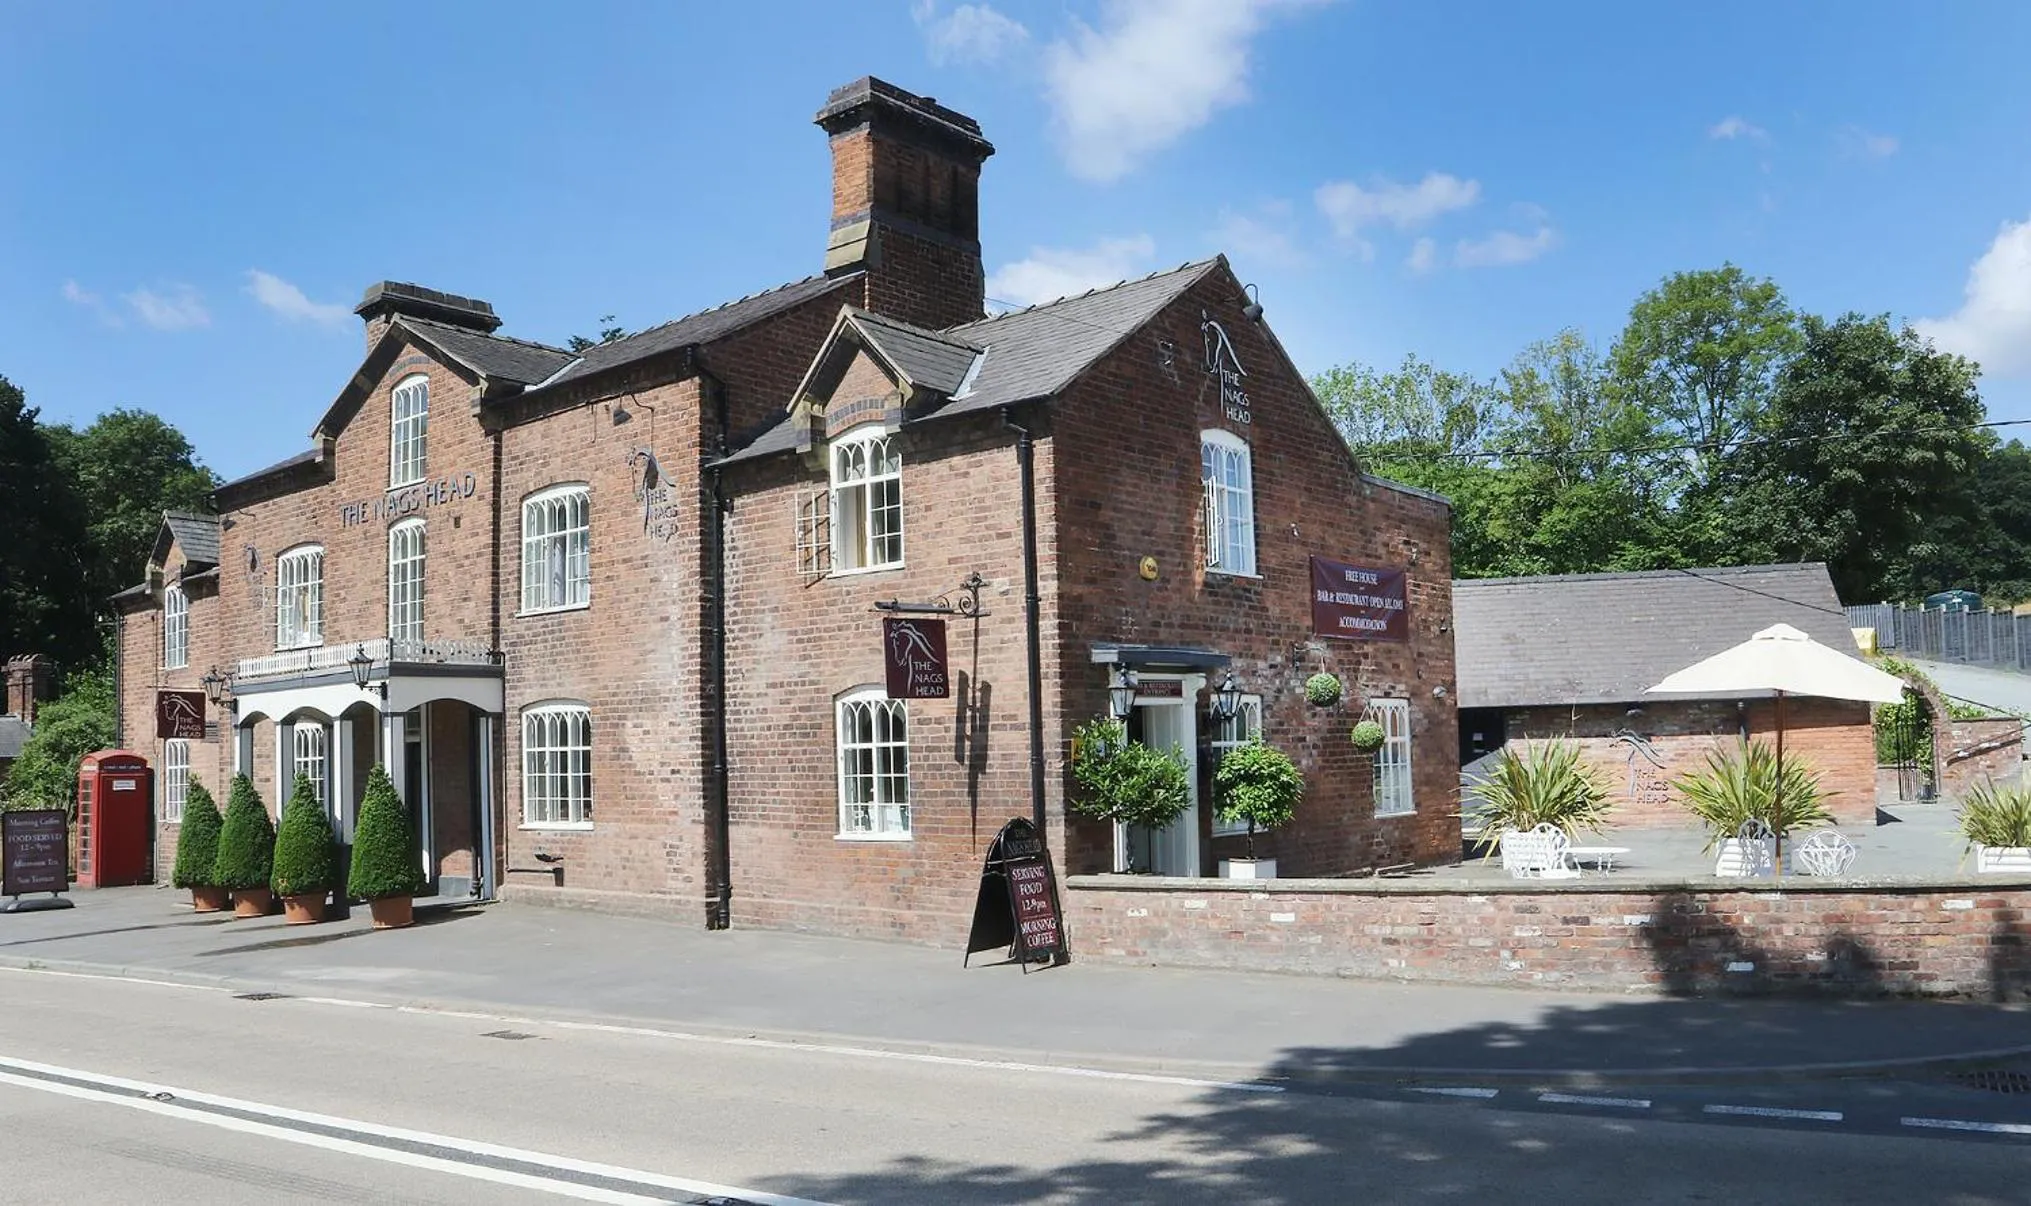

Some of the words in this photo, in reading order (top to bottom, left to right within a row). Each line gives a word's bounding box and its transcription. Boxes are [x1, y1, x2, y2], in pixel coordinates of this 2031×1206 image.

[1223, 370, 1240, 386] THE
[1225, 388, 1250, 406] NAGS
[1226, 407, 1251, 424] HEAD
[339, 501, 369, 528] THE
[374, 487, 421, 521] NAGS
[424, 470, 476, 508] HEAD
[1345, 570, 1359, 582] FREE
[1359, 571, 1378, 585] HOUSE
[1317, 589, 1329, 602] BAR
[1335, 592, 1370, 607] RESTAURANT
[1370, 596, 1384, 609] OPEN
[913, 661, 933, 671] THE
[915, 674, 943, 683] NAGS
[915, 686, 944, 696] HEAD
[180, 716, 193, 724] THE
[1635, 768, 1657, 779] THE
[1636, 781, 1669, 791] NAGS
[8, 834, 32, 843] FOOD
[1012, 865, 1045, 881] SERVING
[1019, 882, 1043, 896] FOOD
[1021, 917, 1057, 935] MORNING
[1027, 931, 1055, 947] COFFEE
